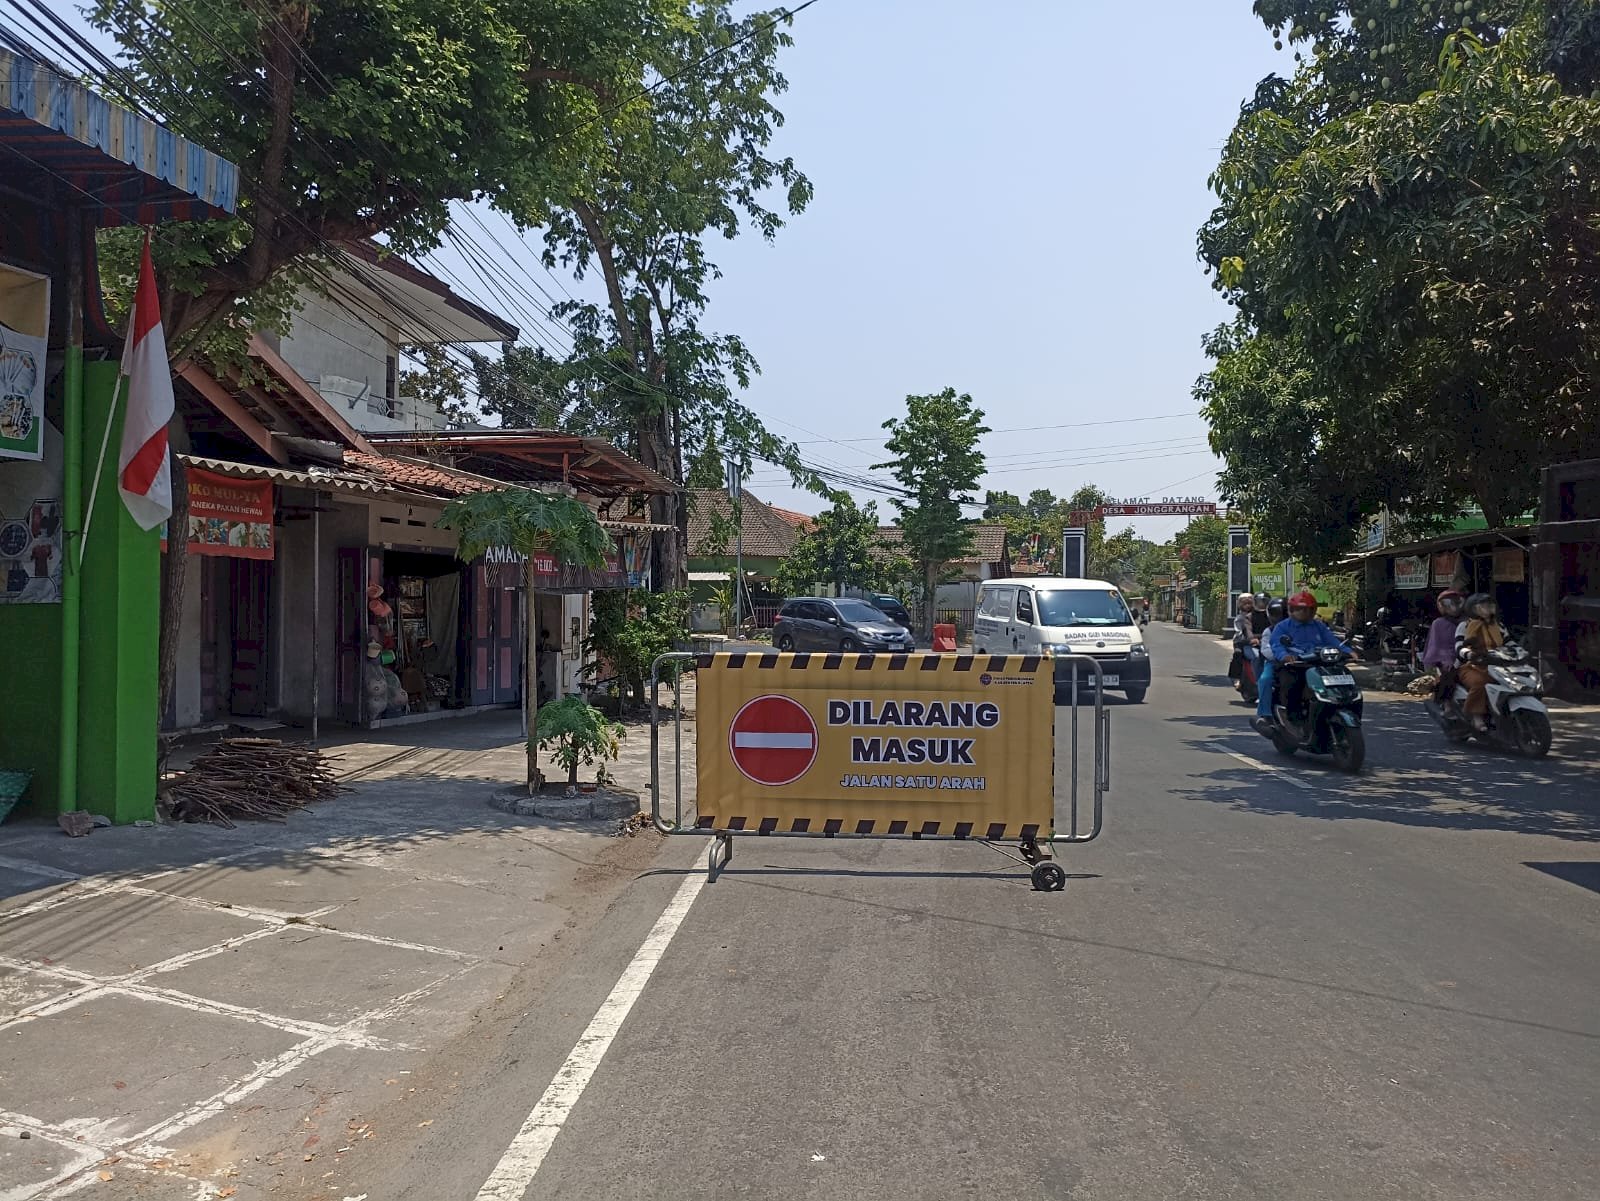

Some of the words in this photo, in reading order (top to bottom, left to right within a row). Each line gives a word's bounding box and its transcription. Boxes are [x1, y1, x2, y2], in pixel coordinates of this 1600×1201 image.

[191, 501, 216, 511] ANEKA
[1162, 496, 1205, 504] DATANG
[1064, 632, 1087, 640] BADAN
[1101, 631, 1131, 639] NASIONAL
[828, 699, 1000, 728] DILARANG
[851, 736, 976, 765] MASUK
[840, 774, 893, 789] JALAN
[895, 776, 938, 789] SATU
[939, 776, 986, 790] ARAH
